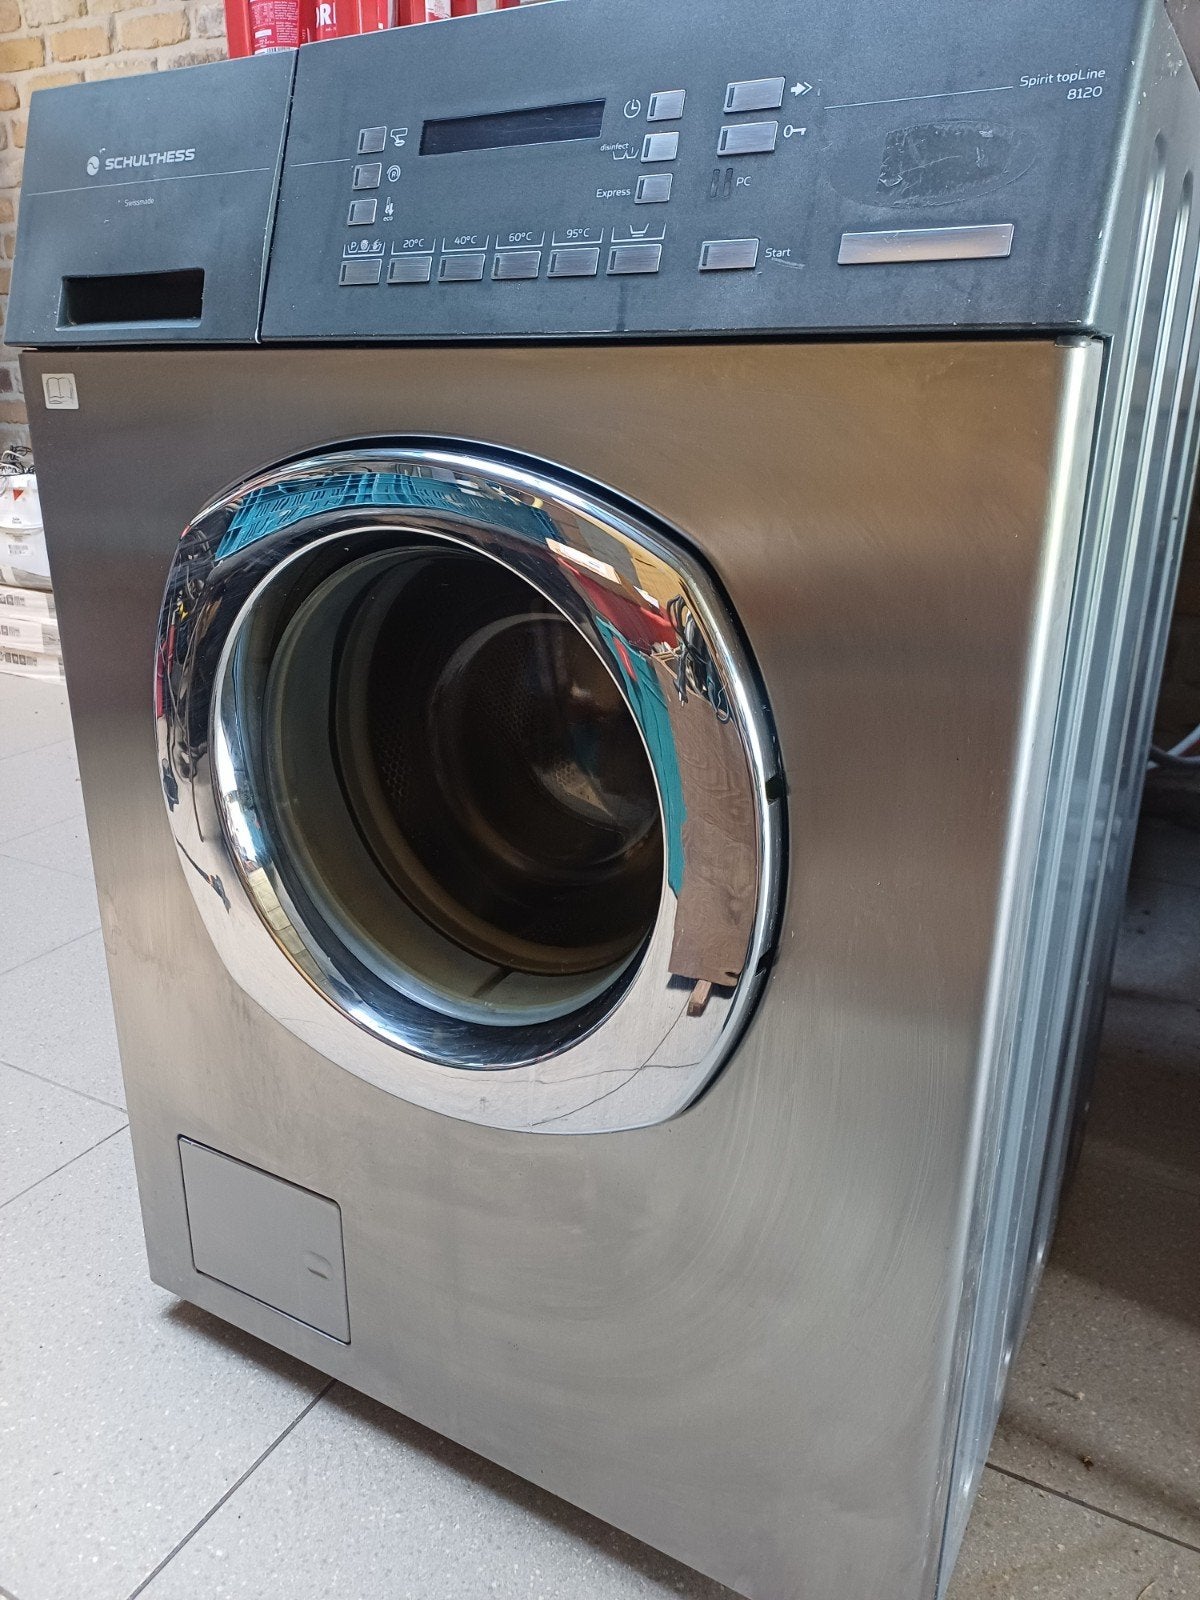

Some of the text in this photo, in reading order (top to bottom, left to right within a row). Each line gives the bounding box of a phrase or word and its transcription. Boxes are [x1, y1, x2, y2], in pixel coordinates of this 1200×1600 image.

[1020, 68, 1106, 88] Spirit topLine
[1067, 86, 1103, 100] 8120
[600, 143, 629, 151] disinfect
[105, 148, 196, 171] SCHULTHESS
[736, 176, 752, 187] PC
[596, 188, 631, 199] Express
[509, 232, 533, 242] 60°C
[566, 228, 591, 238] 95°C
[403, 239, 424, 248] 20°C
[454, 235, 478, 245] 40°C
[765, 248, 791, 258] Start
